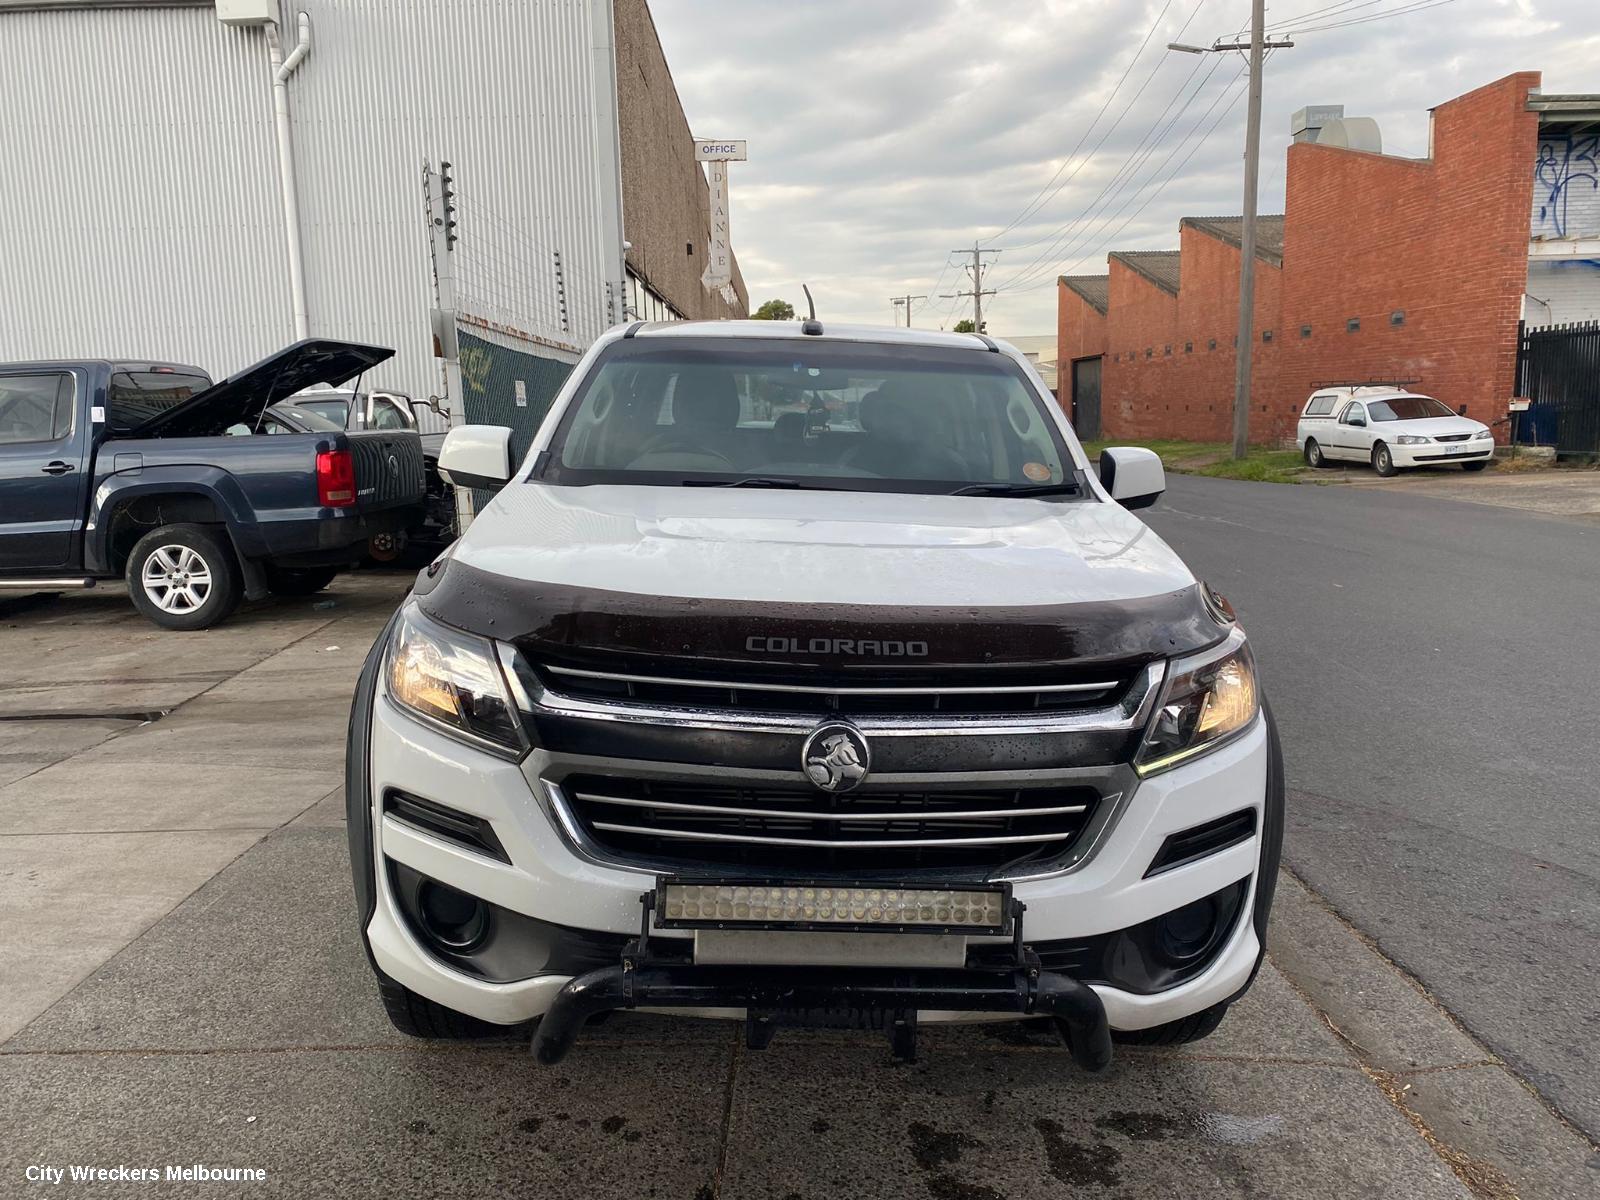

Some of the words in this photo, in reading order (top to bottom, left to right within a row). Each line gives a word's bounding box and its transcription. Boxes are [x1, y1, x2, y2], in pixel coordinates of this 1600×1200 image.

[702, 145, 736, 154] OFFICE
[714, 173, 726, 266] DIANNE
[745, 636, 929, 656] COLORADO
